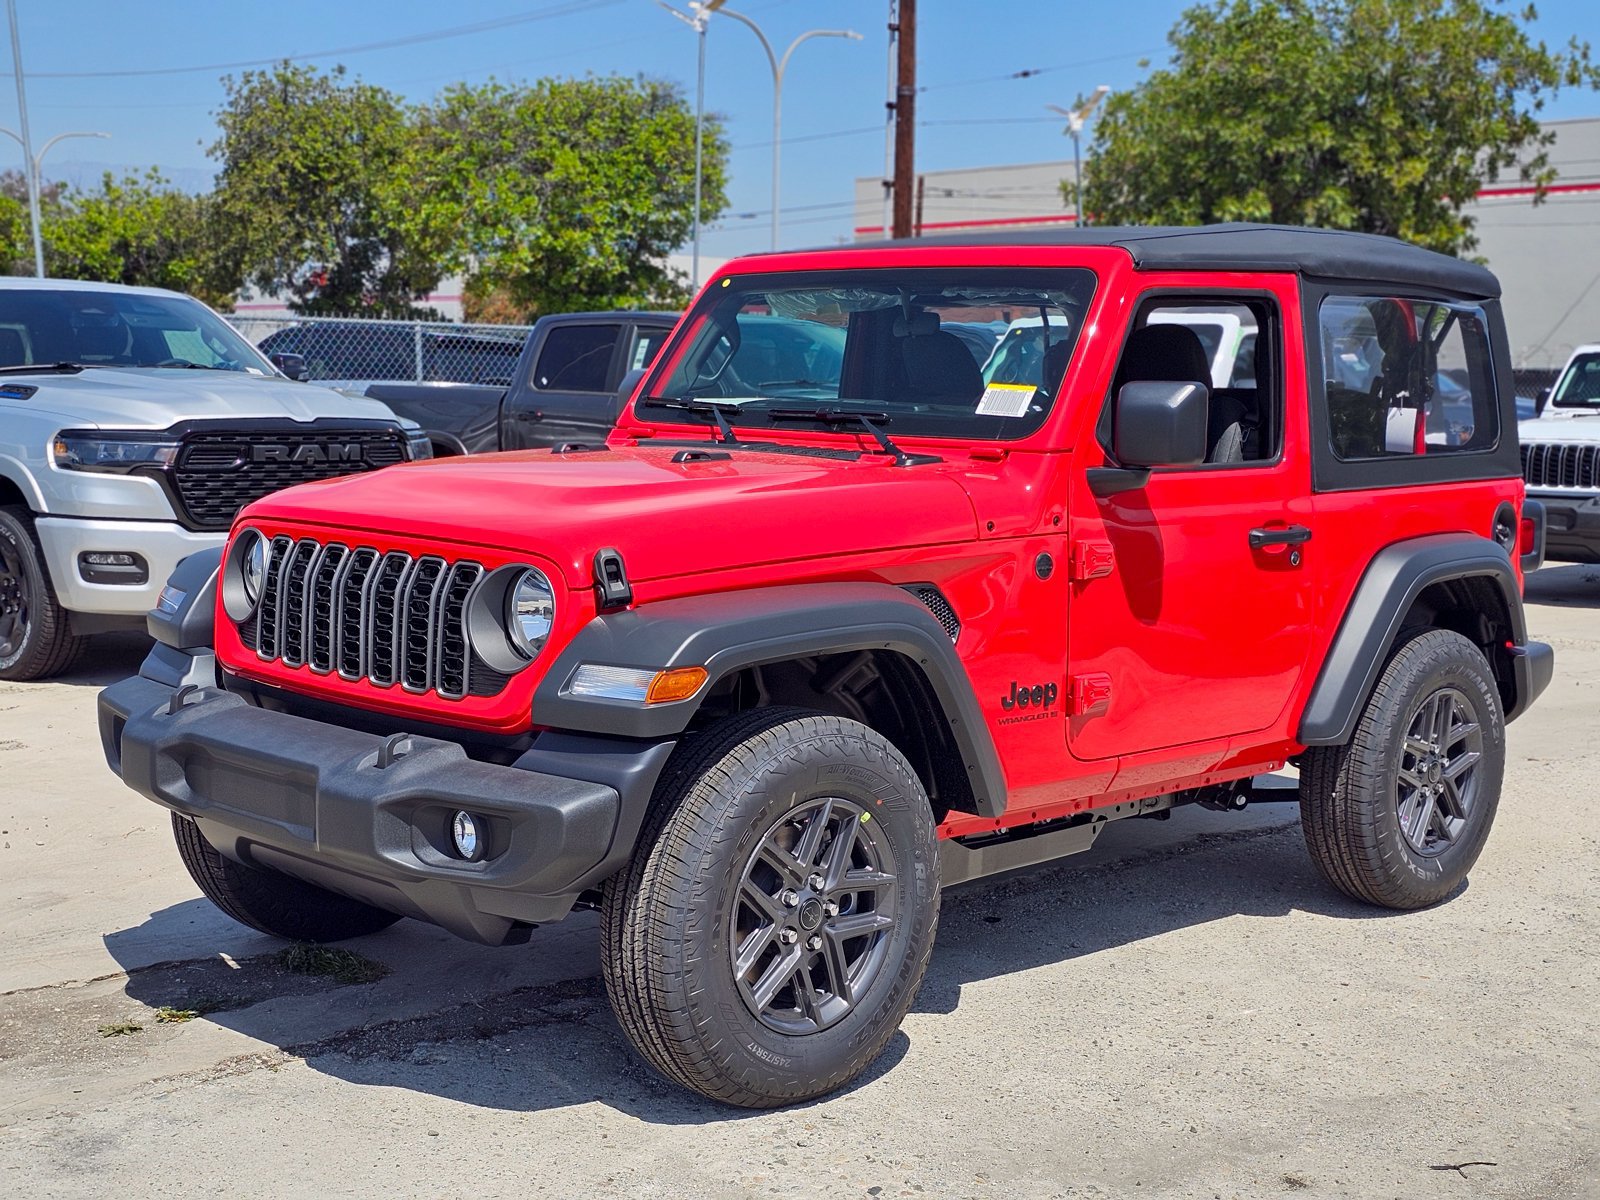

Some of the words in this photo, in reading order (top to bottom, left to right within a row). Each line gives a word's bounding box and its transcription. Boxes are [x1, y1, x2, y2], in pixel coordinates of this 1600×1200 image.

[253, 444, 361, 461] RAM
[1001, 681, 1058, 711] Jeep
[998, 712, 1049, 725] WRANGLER
[712, 806, 768, 939] NEXEN
[747, 1042, 792, 1068] 245/75R17
